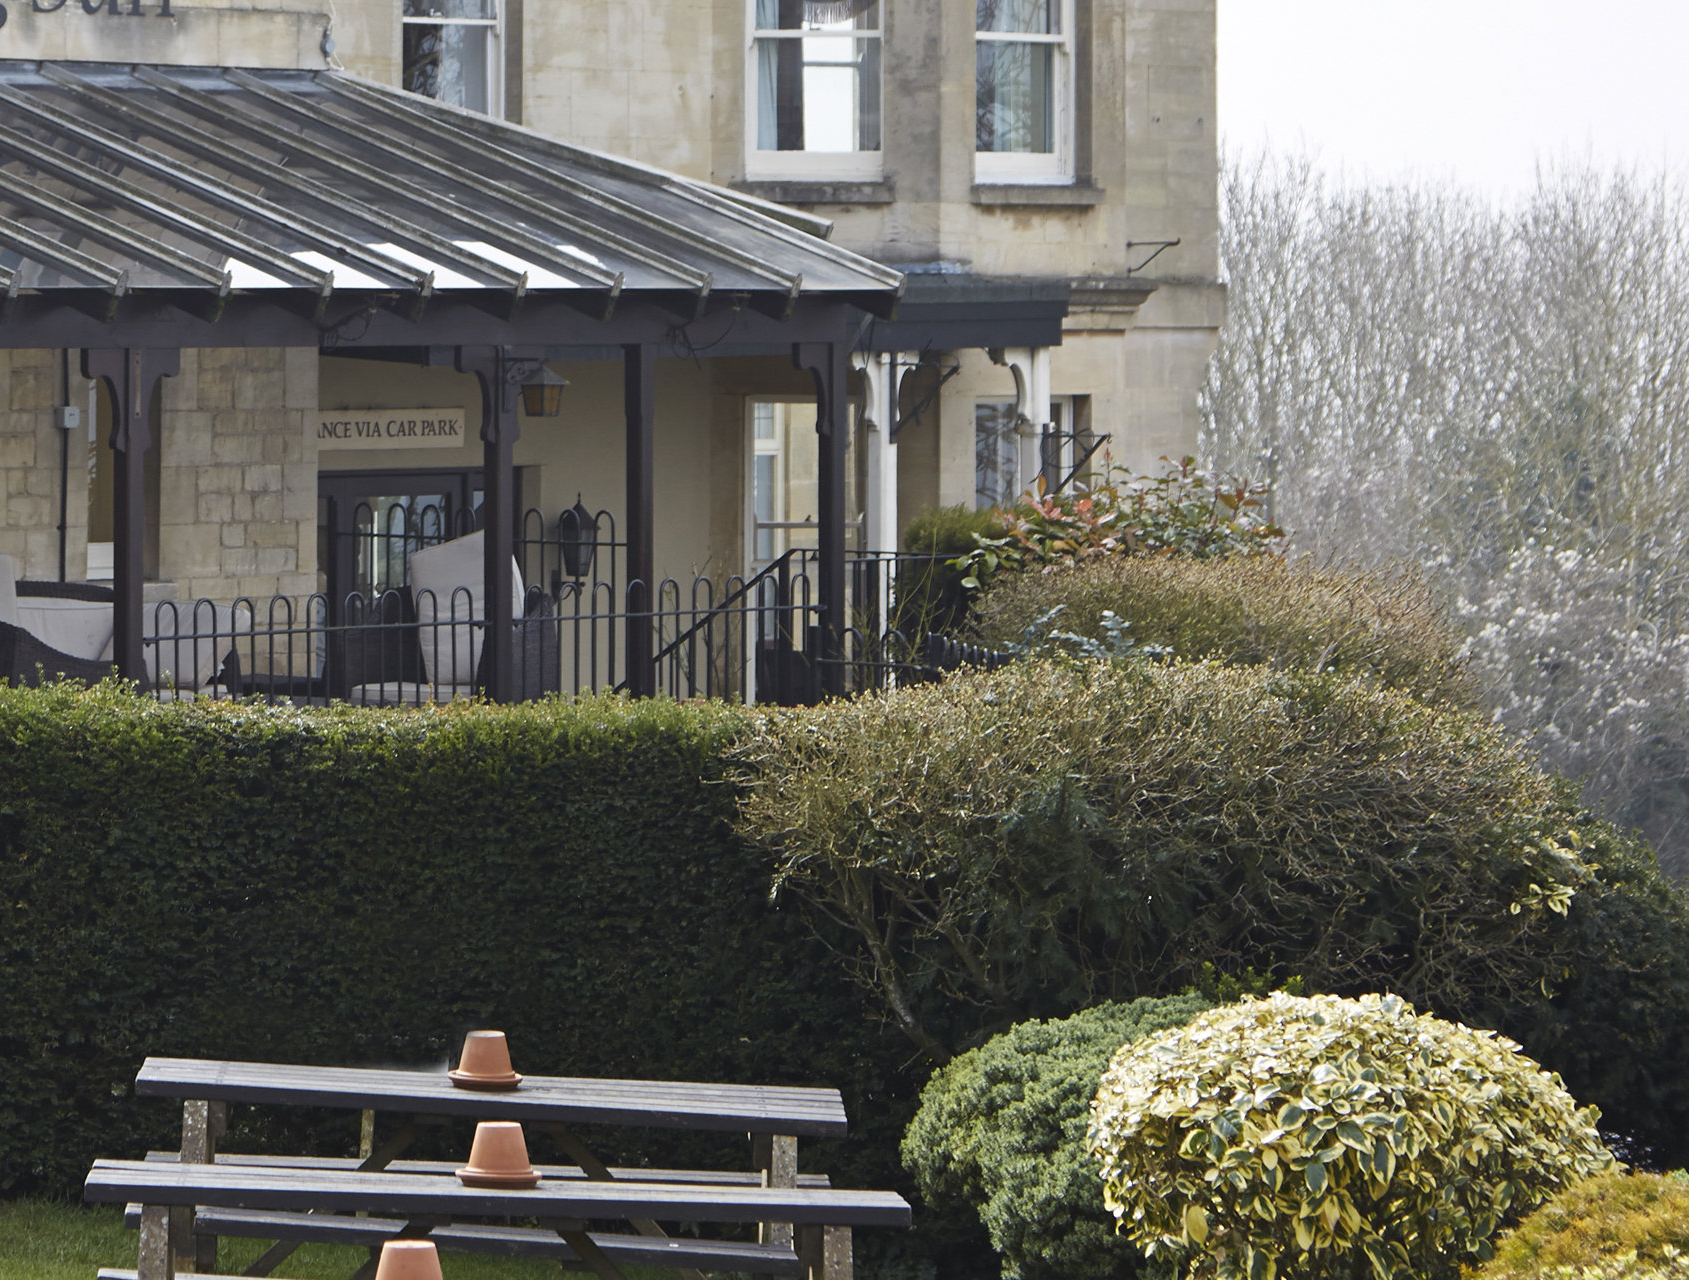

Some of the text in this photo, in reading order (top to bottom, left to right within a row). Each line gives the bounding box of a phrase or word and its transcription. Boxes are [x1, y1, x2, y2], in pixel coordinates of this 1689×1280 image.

[355, 421, 381, 438] VIA
[386, 420, 417, 437] CAR
[421, 419, 459, 436] PARK
